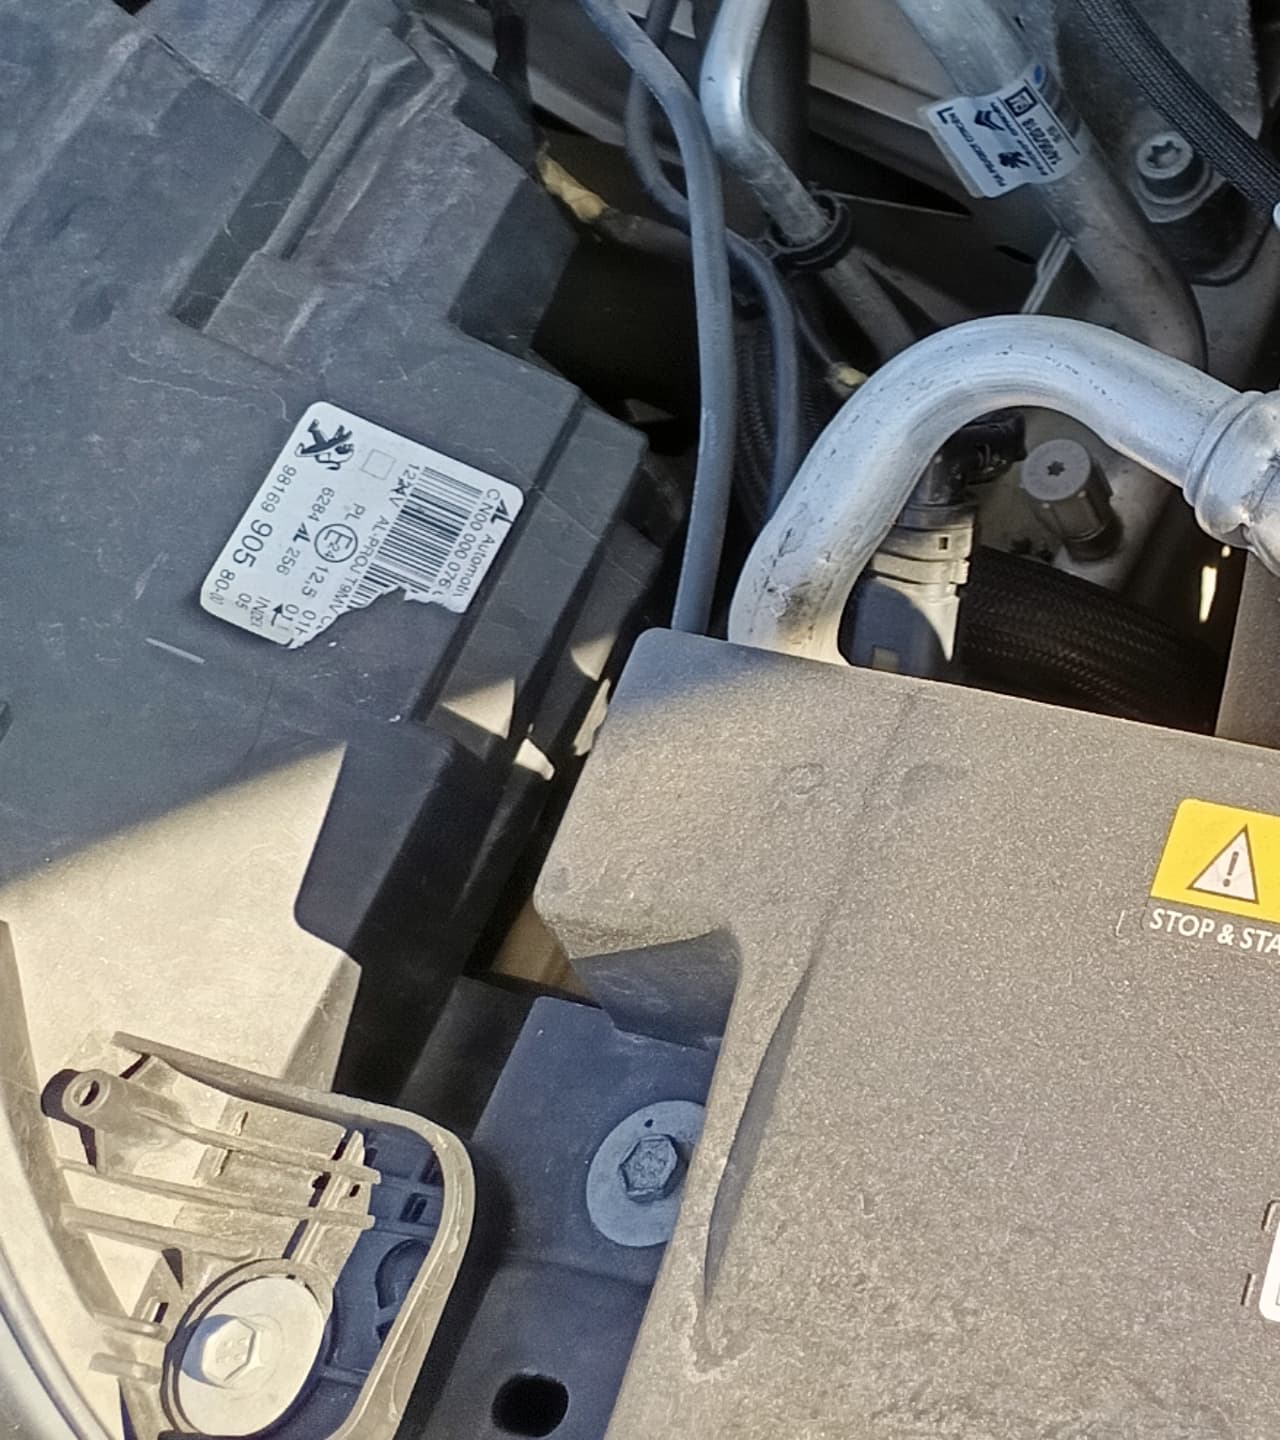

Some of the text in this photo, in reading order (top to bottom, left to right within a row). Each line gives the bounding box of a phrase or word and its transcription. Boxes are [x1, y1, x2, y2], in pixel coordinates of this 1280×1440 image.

[259, 462, 297, 514] 98169
[305, 484, 335, 523] 6284
[344, 501, 365, 525] PL
[230, 516, 274, 570] 905
[274, 545, 300, 576] 256
[453, 531, 477, 561] 000
[299, 561, 330, 600] 12,5
[437, 559, 461, 590] 076
[233, 590, 253, 611] 05
[1149, 907, 1213, 940] STOP
[1216, 923, 1236, 948] &
